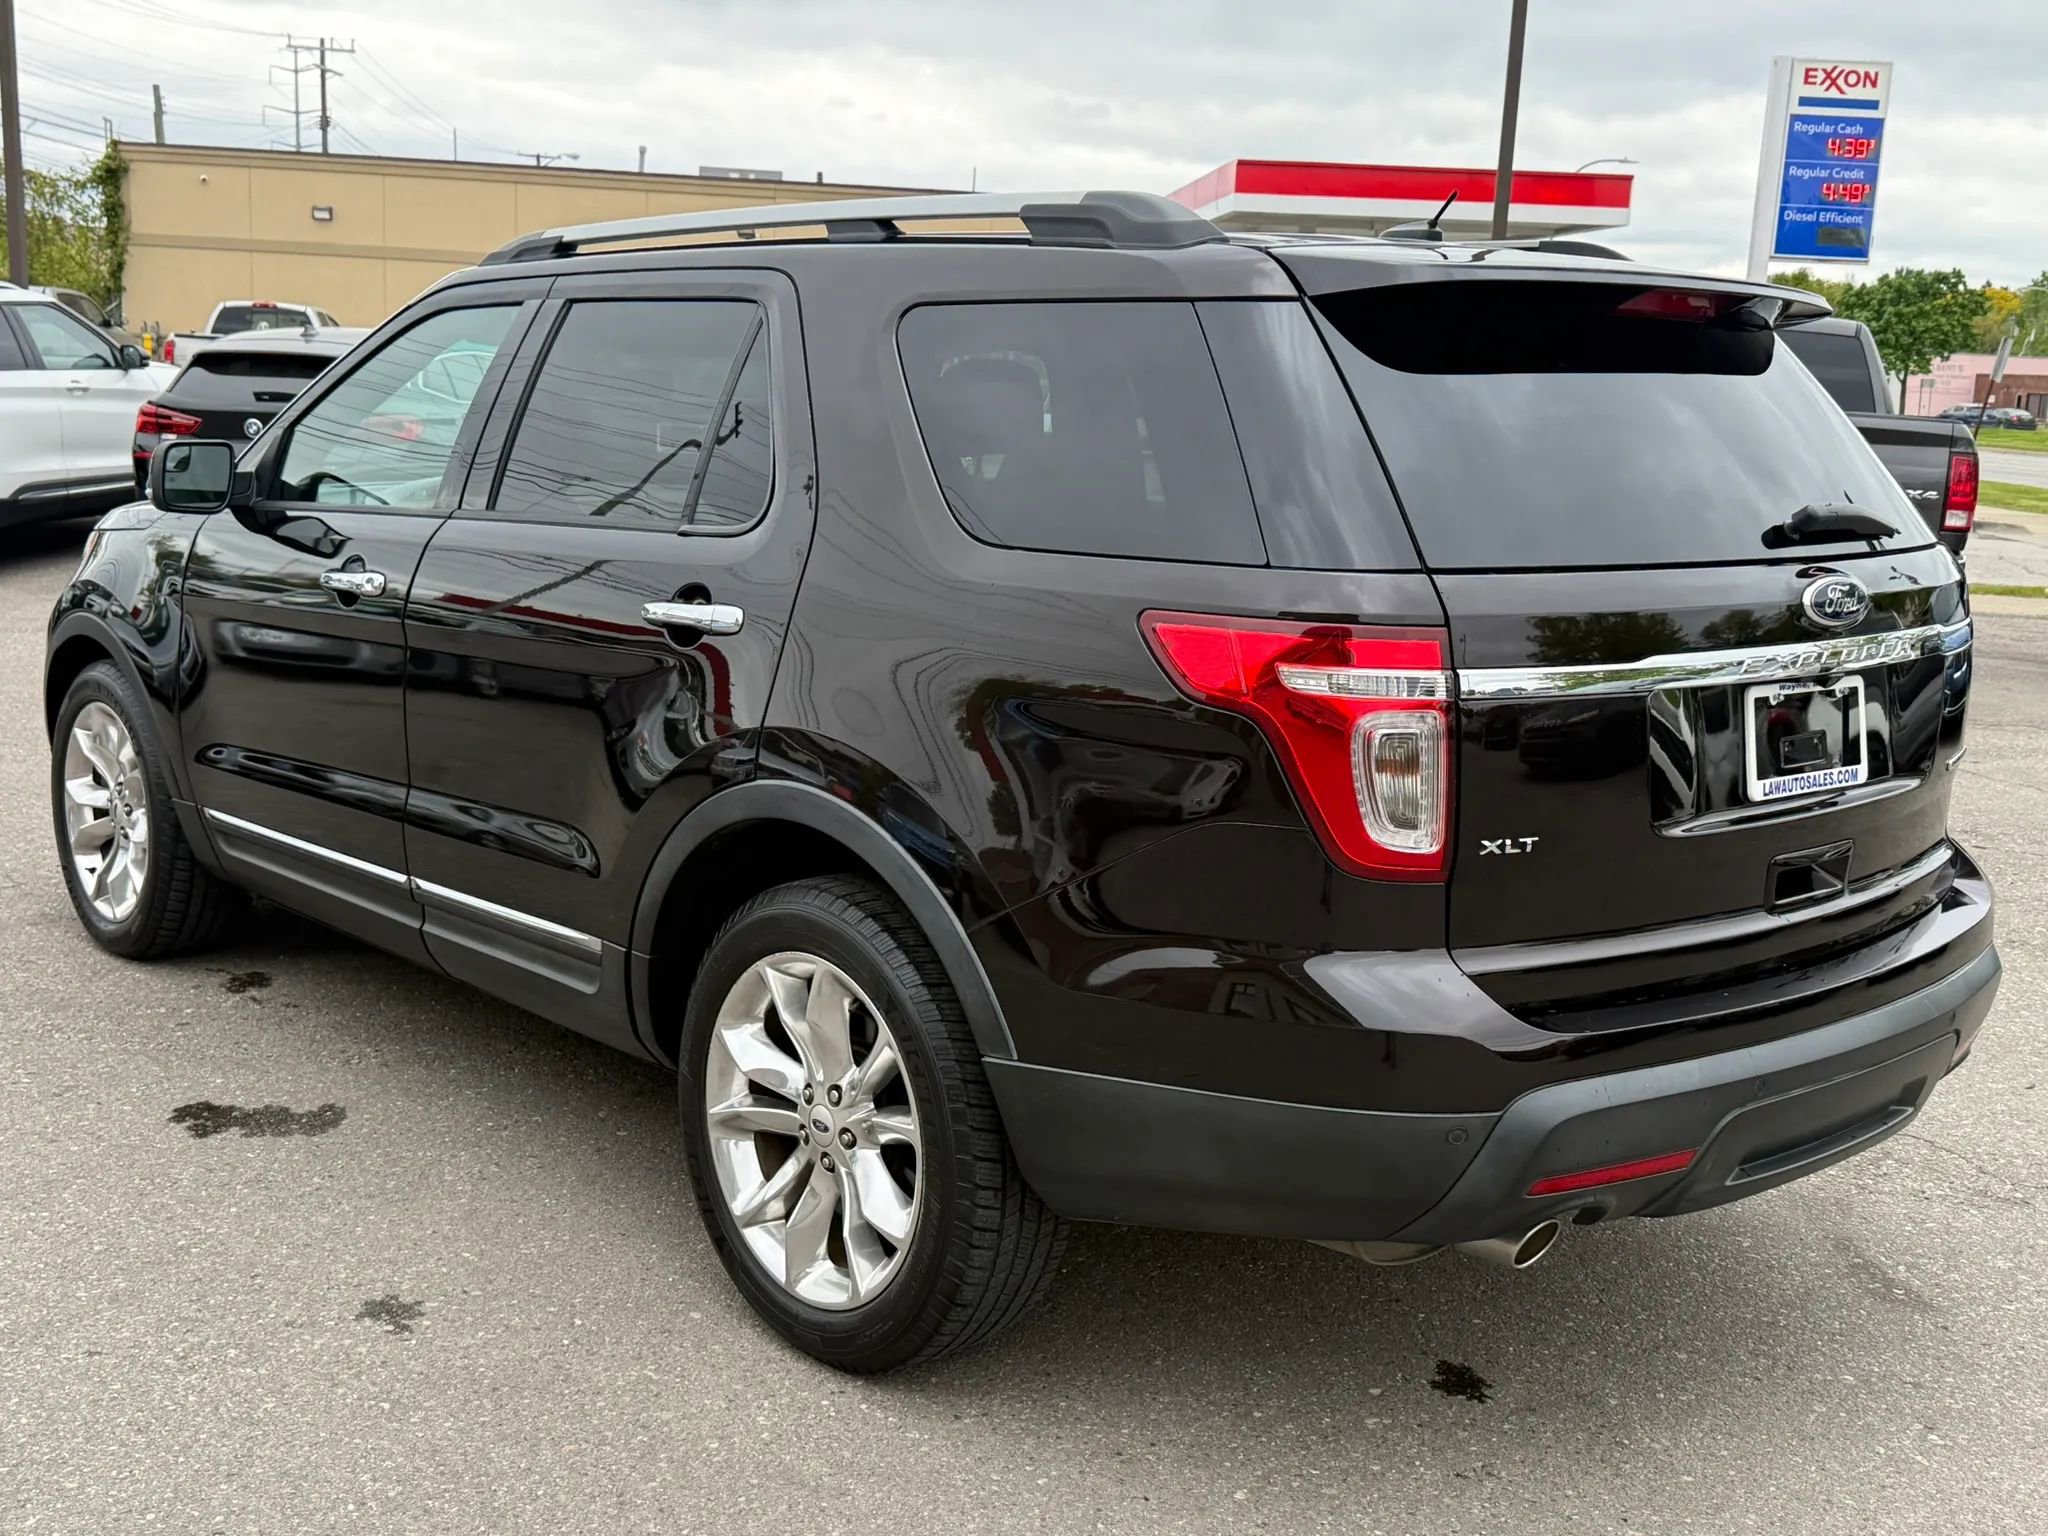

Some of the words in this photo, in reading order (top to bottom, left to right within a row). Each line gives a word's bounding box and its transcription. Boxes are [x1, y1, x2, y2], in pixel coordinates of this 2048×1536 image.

[1803, 65, 1880, 95] EXXON
[1794, 121, 1836, 135] Regular
[1837, 123, 1863, 134] Cash
[1789, 165, 1831, 179] Regular
[1832, 167, 1865, 180] Credit
[1784, 209, 1817, 222] Diesel
[1819, 211, 1864, 224] Efficient
[1825, 584, 1863, 613] Ford
[1740, 638, 1914, 674] EXPLORER
[1763, 767, 1858, 797] LAWAUTOSALES.COM
[1479, 836, 1540, 855] XLT
